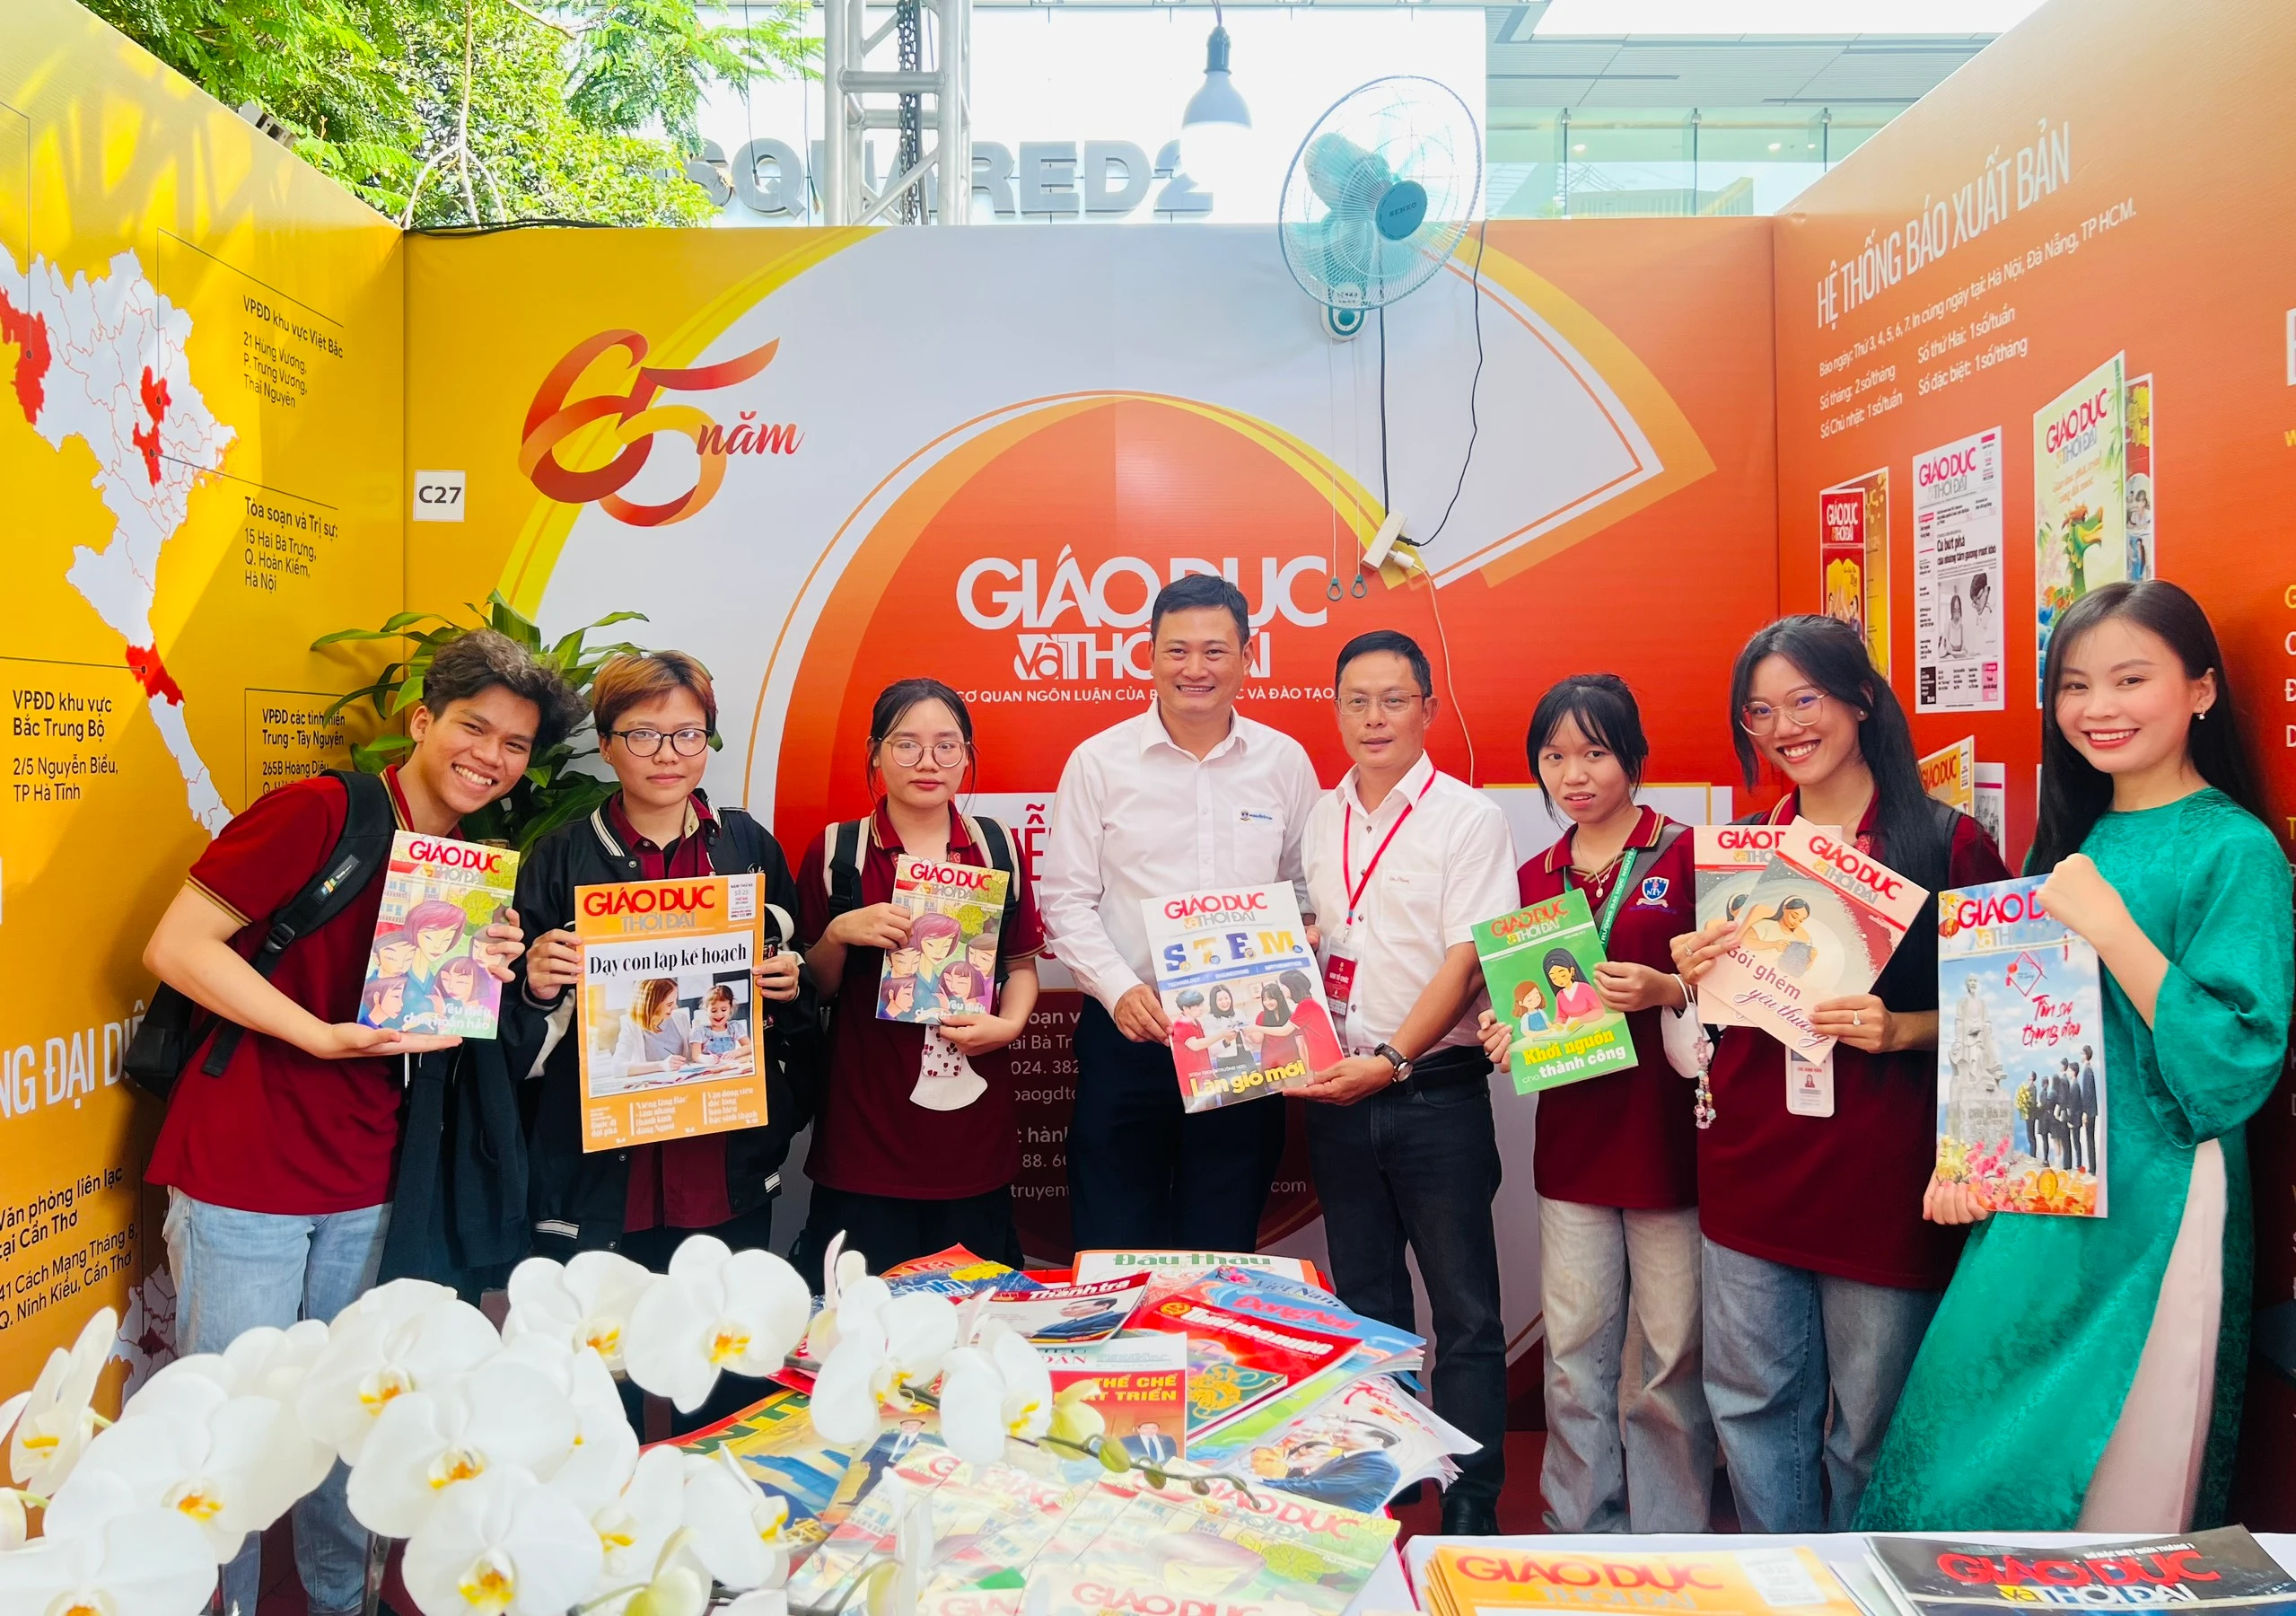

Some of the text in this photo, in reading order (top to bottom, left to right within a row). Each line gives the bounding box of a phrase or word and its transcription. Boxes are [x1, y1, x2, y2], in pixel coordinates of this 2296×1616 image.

[1817, 117, 2070, 330] HỆ THỐNG BÁO XUẤT BẢN
[1987, 267, 2002, 290] Hà
[2027, 245, 2043, 269] Đà
[2080, 217, 2097, 242] TP
[243, 294, 344, 358] VPĐD khu vực Việt Bắc
[243, 331, 307, 374] 21 Hùng Vương,
[253, 356, 277, 383] Trưng
[279, 368, 308, 395] Vương,
[264, 382, 295, 408] Nguyên
[695, 409, 806, 456] năm
[1919, 456, 1950, 487] GIÁO
[418, 485, 462, 505] C27
[245, 496, 338, 541] Tòa soạn và Trị sự:
[245, 527, 317, 562] 15 Hai Bà Trưng,
[245, 549, 311, 578] Q. Hoàn Kiếm,
[245, 569, 276, 594] Hà Nội
[956, 543, 1161, 630] GIÁO
[13, 689, 112, 717] VPĐD khu vực
[979, 689, 1021, 704] QUAN
[1025, 686, 1072, 702] NGÔN
[1074, 686, 1113, 705] LUẬN
[1115, 685, 1147, 701] CỦA
[1248, 685, 1266, 700] VÀ
[1268, 685, 1308, 700] ĐÀO
[1310, 688, 1335, 702] TẠO
[13, 714, 105, 742] Bắc Trung Bộ
[262, 707, 306, 725] VPĐD các
[262, 729, 344, 749] Trung Tây Nguyên
[13, 754, 118, 779] 2/5 Nguyễn Biểu,
[262, 759, 311, 777] 265B Hoàng
[13, 782, 81, 802] TP Hà Tĩnh
[1718, 828, 1772, 849] GIÁO
[408, 840, 503, 874] GIÁO DỤC
[1809, 836, 1905, 900] GIÁO DỤC
[910, 863, 993, 891] GIÁO DỤC
[583, 887, 656, 917] GIÁO
[660, 885, 715, 913] DỤC
[1164, 892, 1267, 919] GIÁO DỤC
[1959, 892, 2025, 928] GIÁO
[620, 911, 697, 933] THỜI ĐẠI
[1198, 910, 1256, 928] THỜI ĐẠI
[590, 943, 747, 977] Dạy con lập kế hoạch
[1727, 945, 1801, 1000] Gói ghém
[1732, 987, 1779, 1011] yêu
[1029, 1012, 1064, 1029] oạn
[1031, 1033, 1052, 1050] Bà
[1522, 1028, 1615, 1065] Khởi nguồn
[0, 1027, 95, 1119] NG ĐẠI
[1231, 1069, 1264, 1093] gió
[1264, 1059, 1307, 1083] mới
[1538, 1045, 1626, 1078] thành công
[1522, 1074, 1540, 1084] cho
[29, 1167, 123, 1224] phòng liên lạc
[1270, 1181, 1307, 1193] com
[20, 1209, 78, 1248] Cần Thơ
[15, 1234, 125, 1294] Cách Mạng Tháng
[17, 1250, 132, 1322] Ninh Kiều, Cần Thơ
[1092, 1373, 1179, 1388] THẾ CHẾ
[1115, 1387, 1178, 1401] TRIỂN
[1456, 1555, 1723, 1594] GIÁO DỤC
[1937, 1550, 2222, 1586] GIÁO DỤC
[1072, 1581, 1176, 1616] GIÁO
